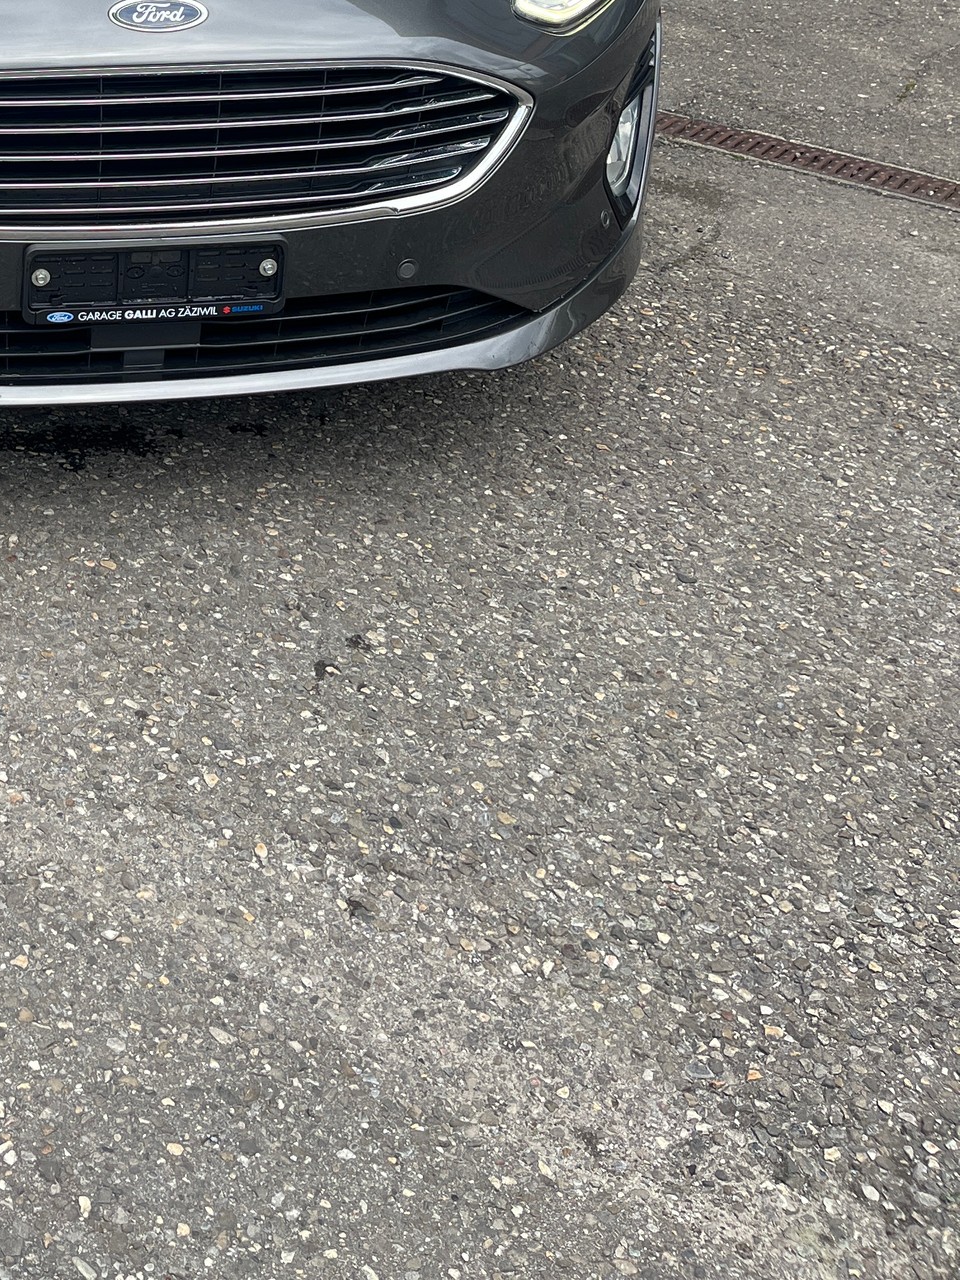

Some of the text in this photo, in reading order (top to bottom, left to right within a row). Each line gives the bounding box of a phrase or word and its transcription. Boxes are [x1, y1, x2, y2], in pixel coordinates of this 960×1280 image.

[77, 310, 122, 321] GARAGE
[124, 308, 156, 319] GALLI
[159, 308, 175, 318] AG
[178, 305, 218, 317] ZÄZIWIL
[231, 305, 263, 313] SUZUKI
